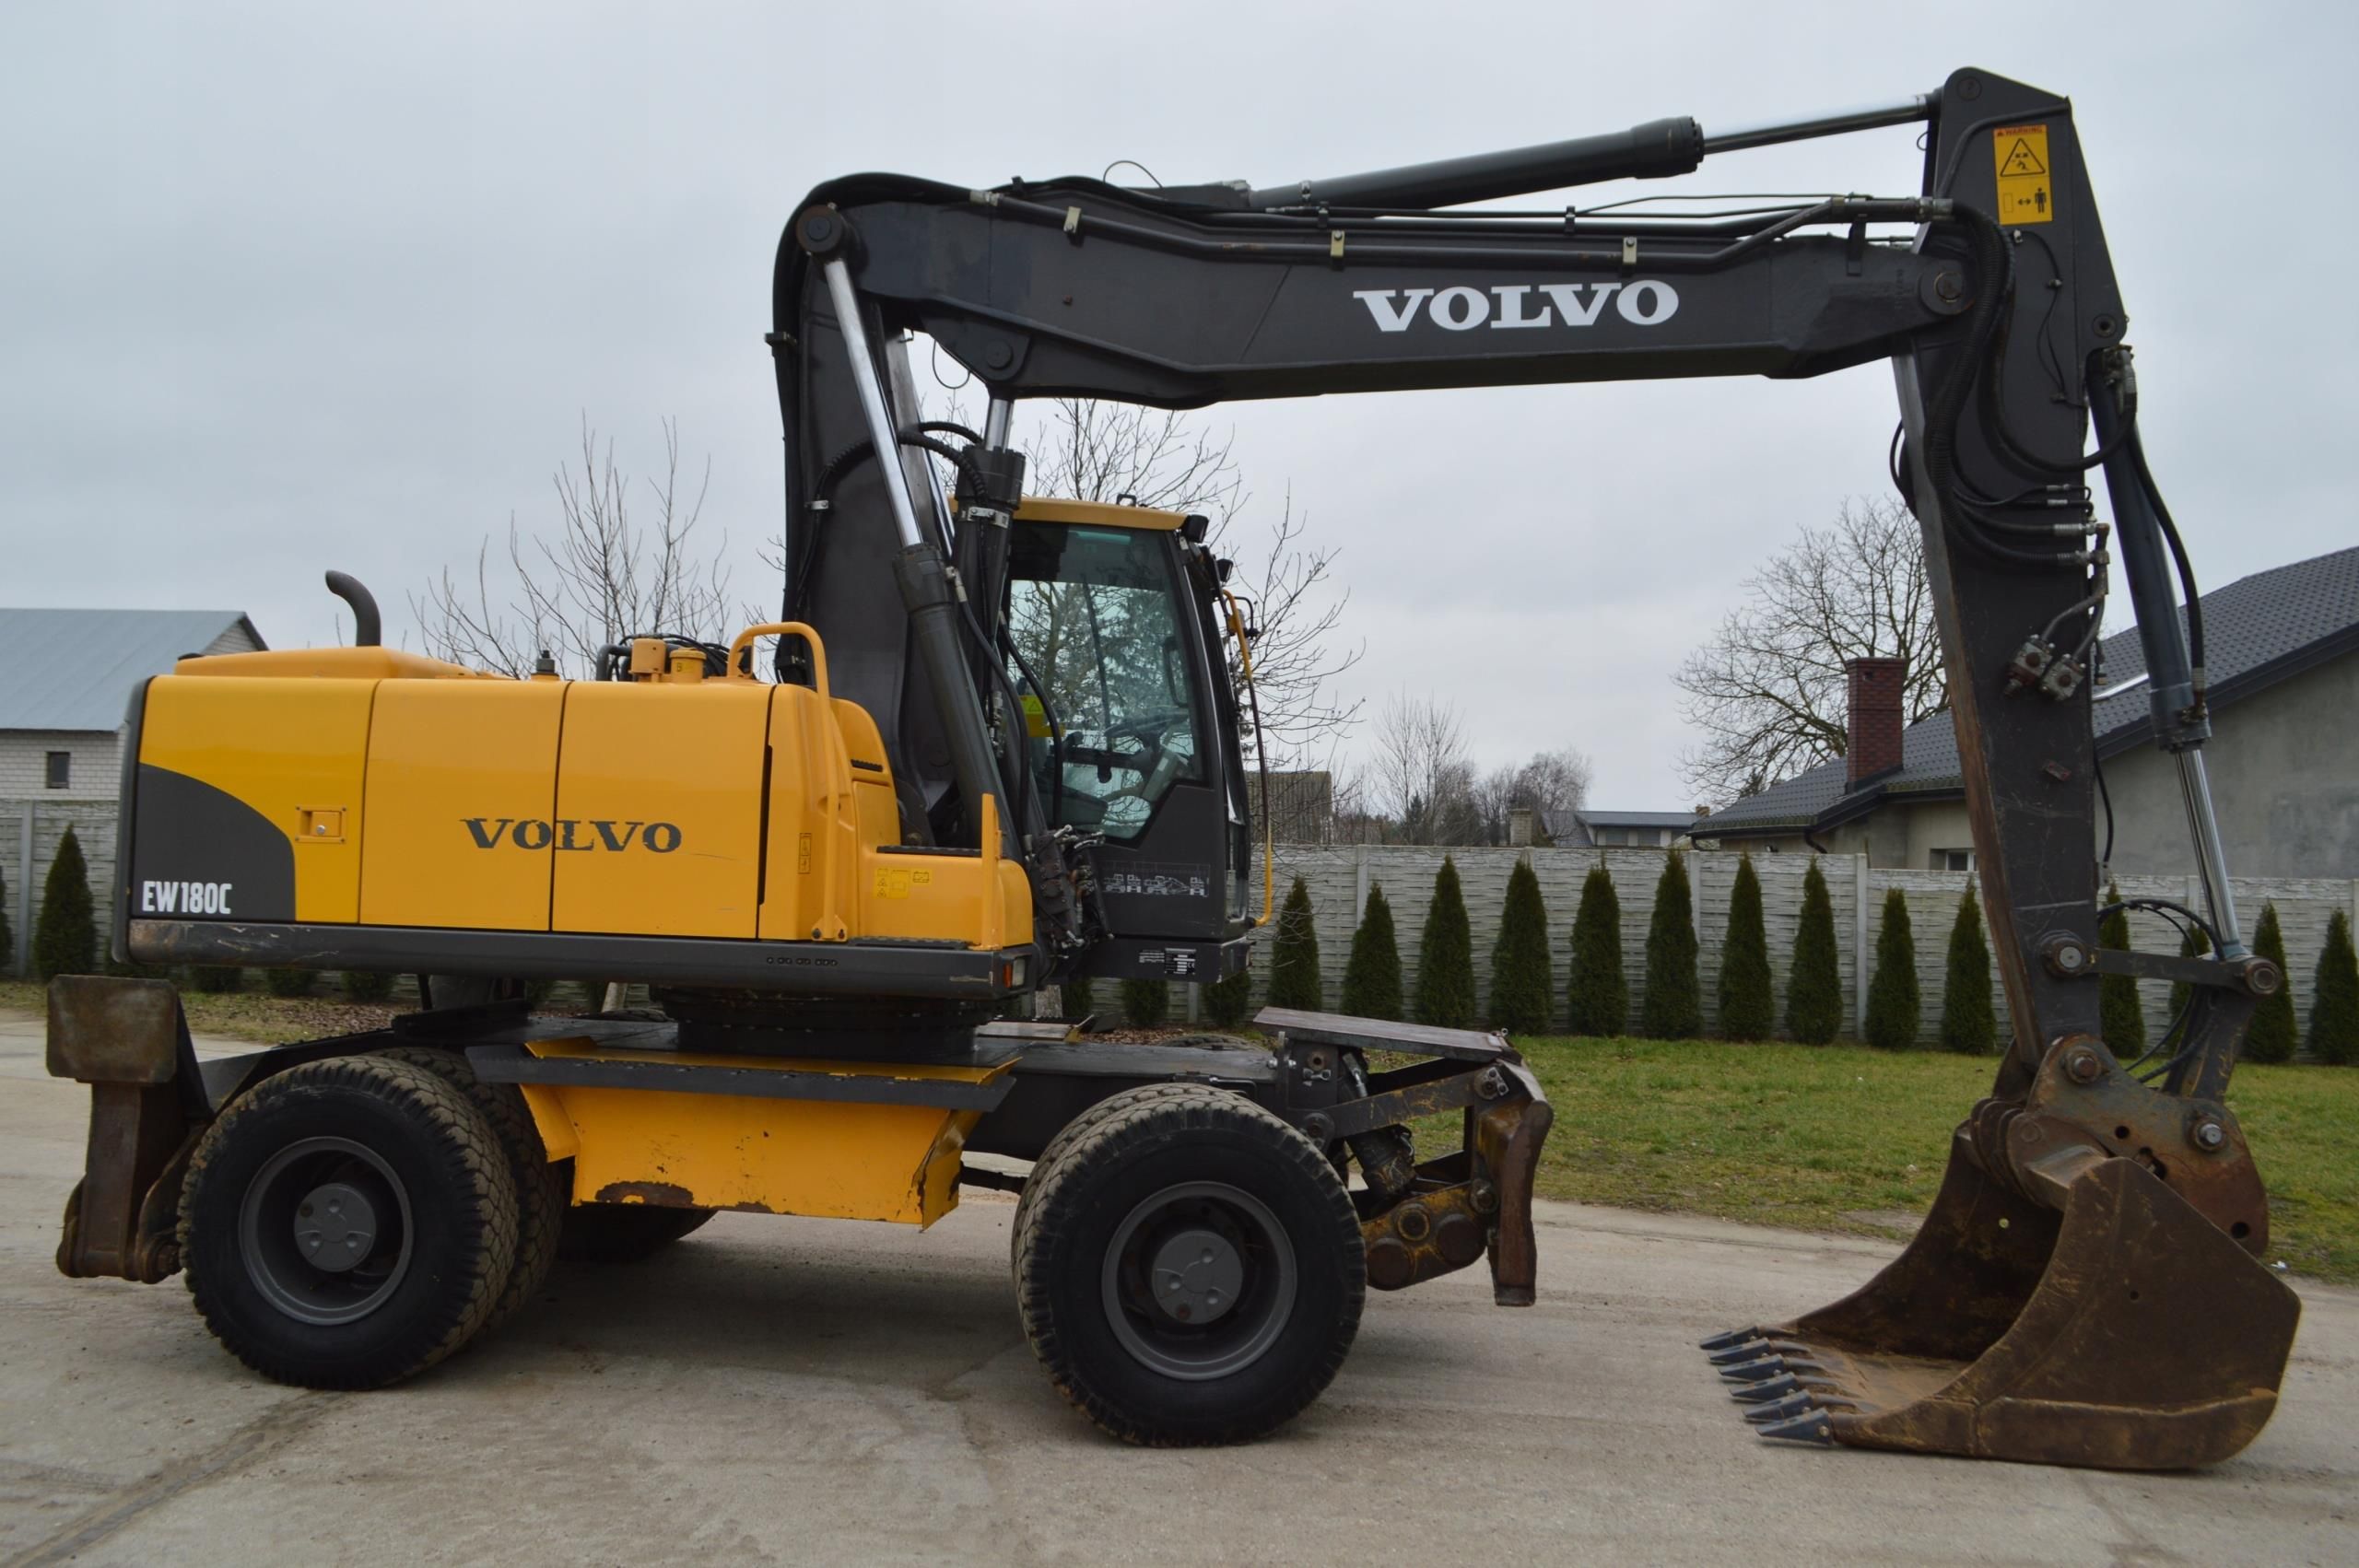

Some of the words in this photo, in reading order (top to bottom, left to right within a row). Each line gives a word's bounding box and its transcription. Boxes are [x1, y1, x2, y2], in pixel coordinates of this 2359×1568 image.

[1353, 279, 1679, 332] VOLVO
[459, 818, 682, 853] VOLVO
[142, 880, 232, 915] EW180C
